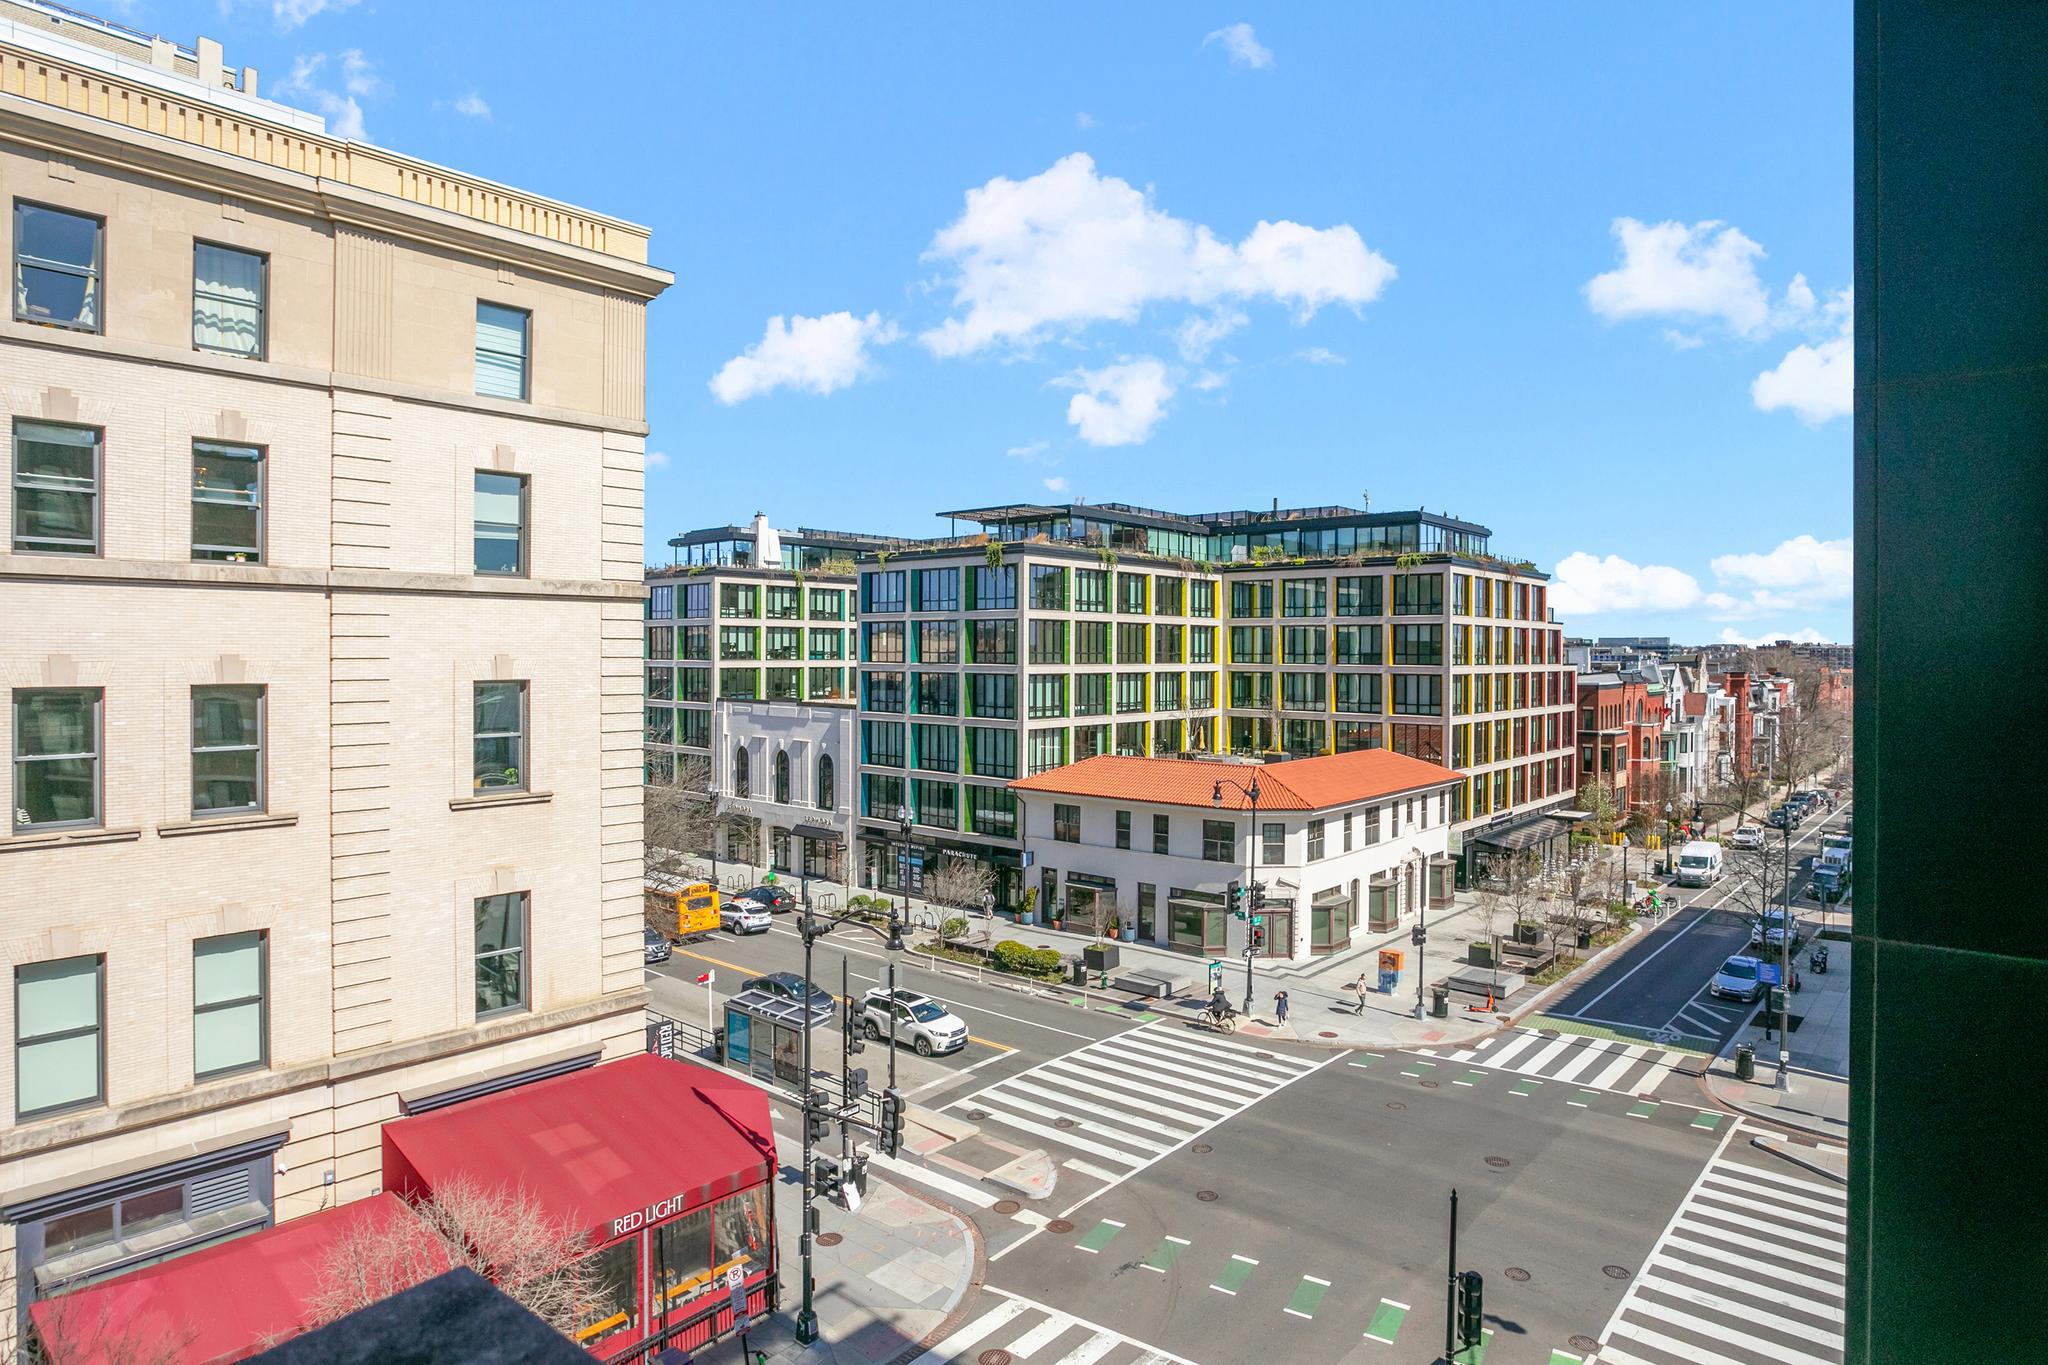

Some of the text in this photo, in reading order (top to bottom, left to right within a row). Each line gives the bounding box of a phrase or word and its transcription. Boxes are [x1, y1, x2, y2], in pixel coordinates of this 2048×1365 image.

[942, 849, 977, 859] PARACHUTE
[659, 1023, 673, 1059] RED LIG
[614, 1194, 684, 1235] RED LIGHT
